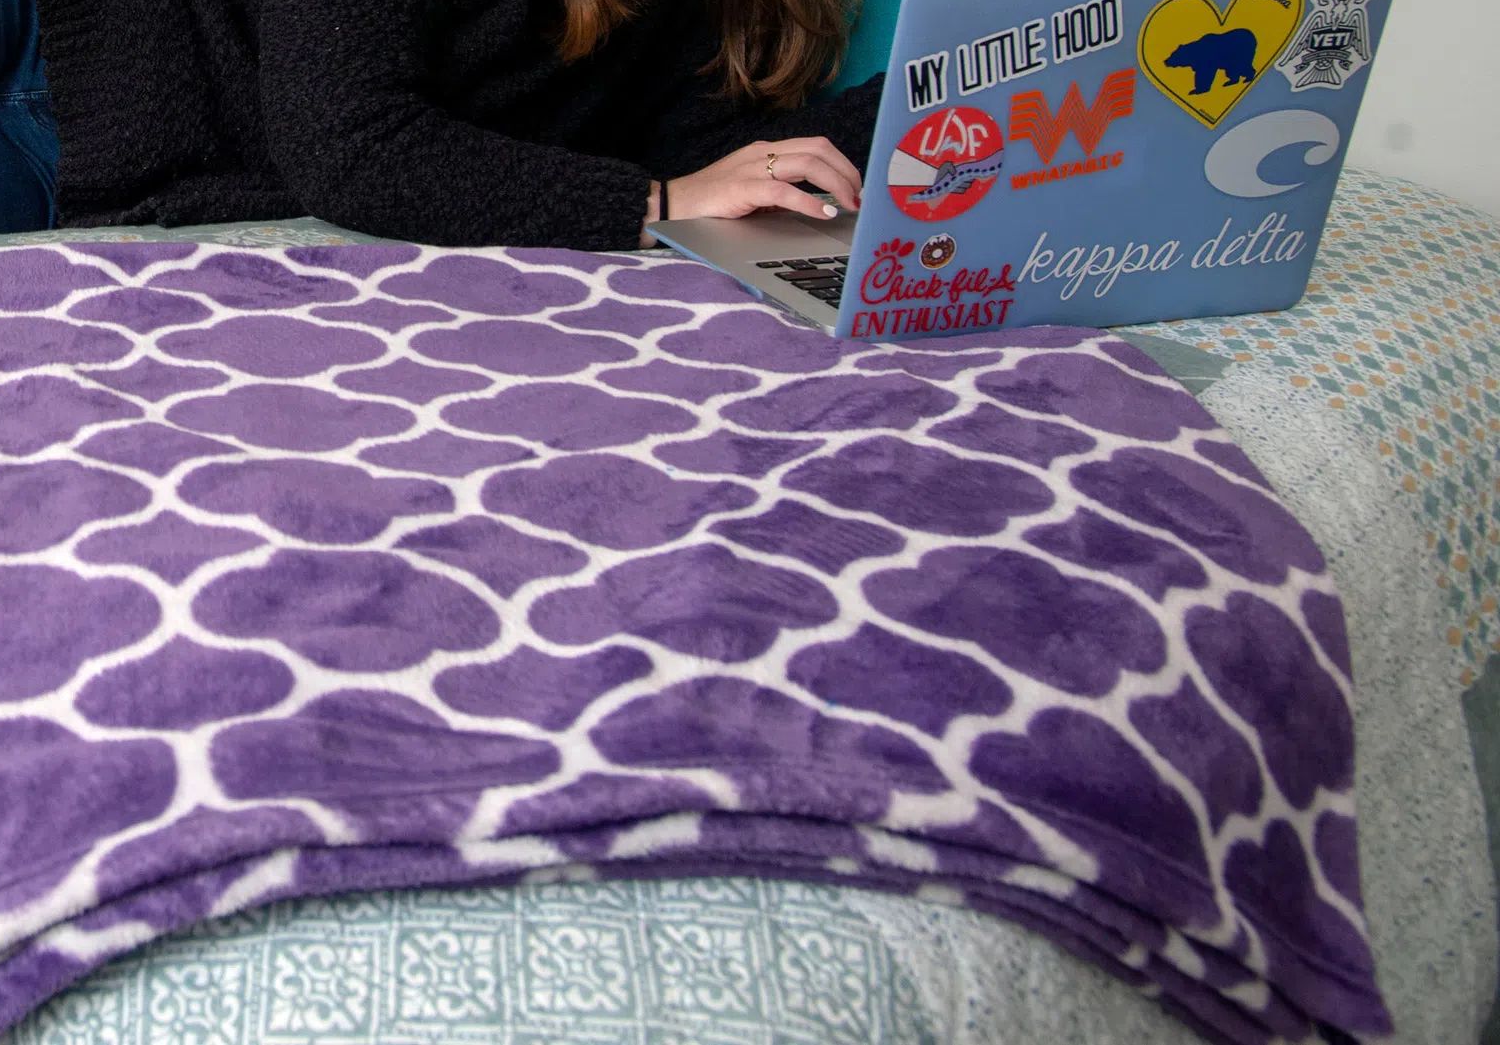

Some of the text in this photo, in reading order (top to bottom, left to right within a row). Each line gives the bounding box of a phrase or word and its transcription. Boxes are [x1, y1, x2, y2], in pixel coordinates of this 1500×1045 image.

[908, 55, 945, 109] MY
[958, 21, 1043, 92] LITTLE
[1312, 31, 1352, 48] YETI
[1016, 211, 1308, 301] kappa delta
[851, 299, 1015, 338] ENTHUSIAST
